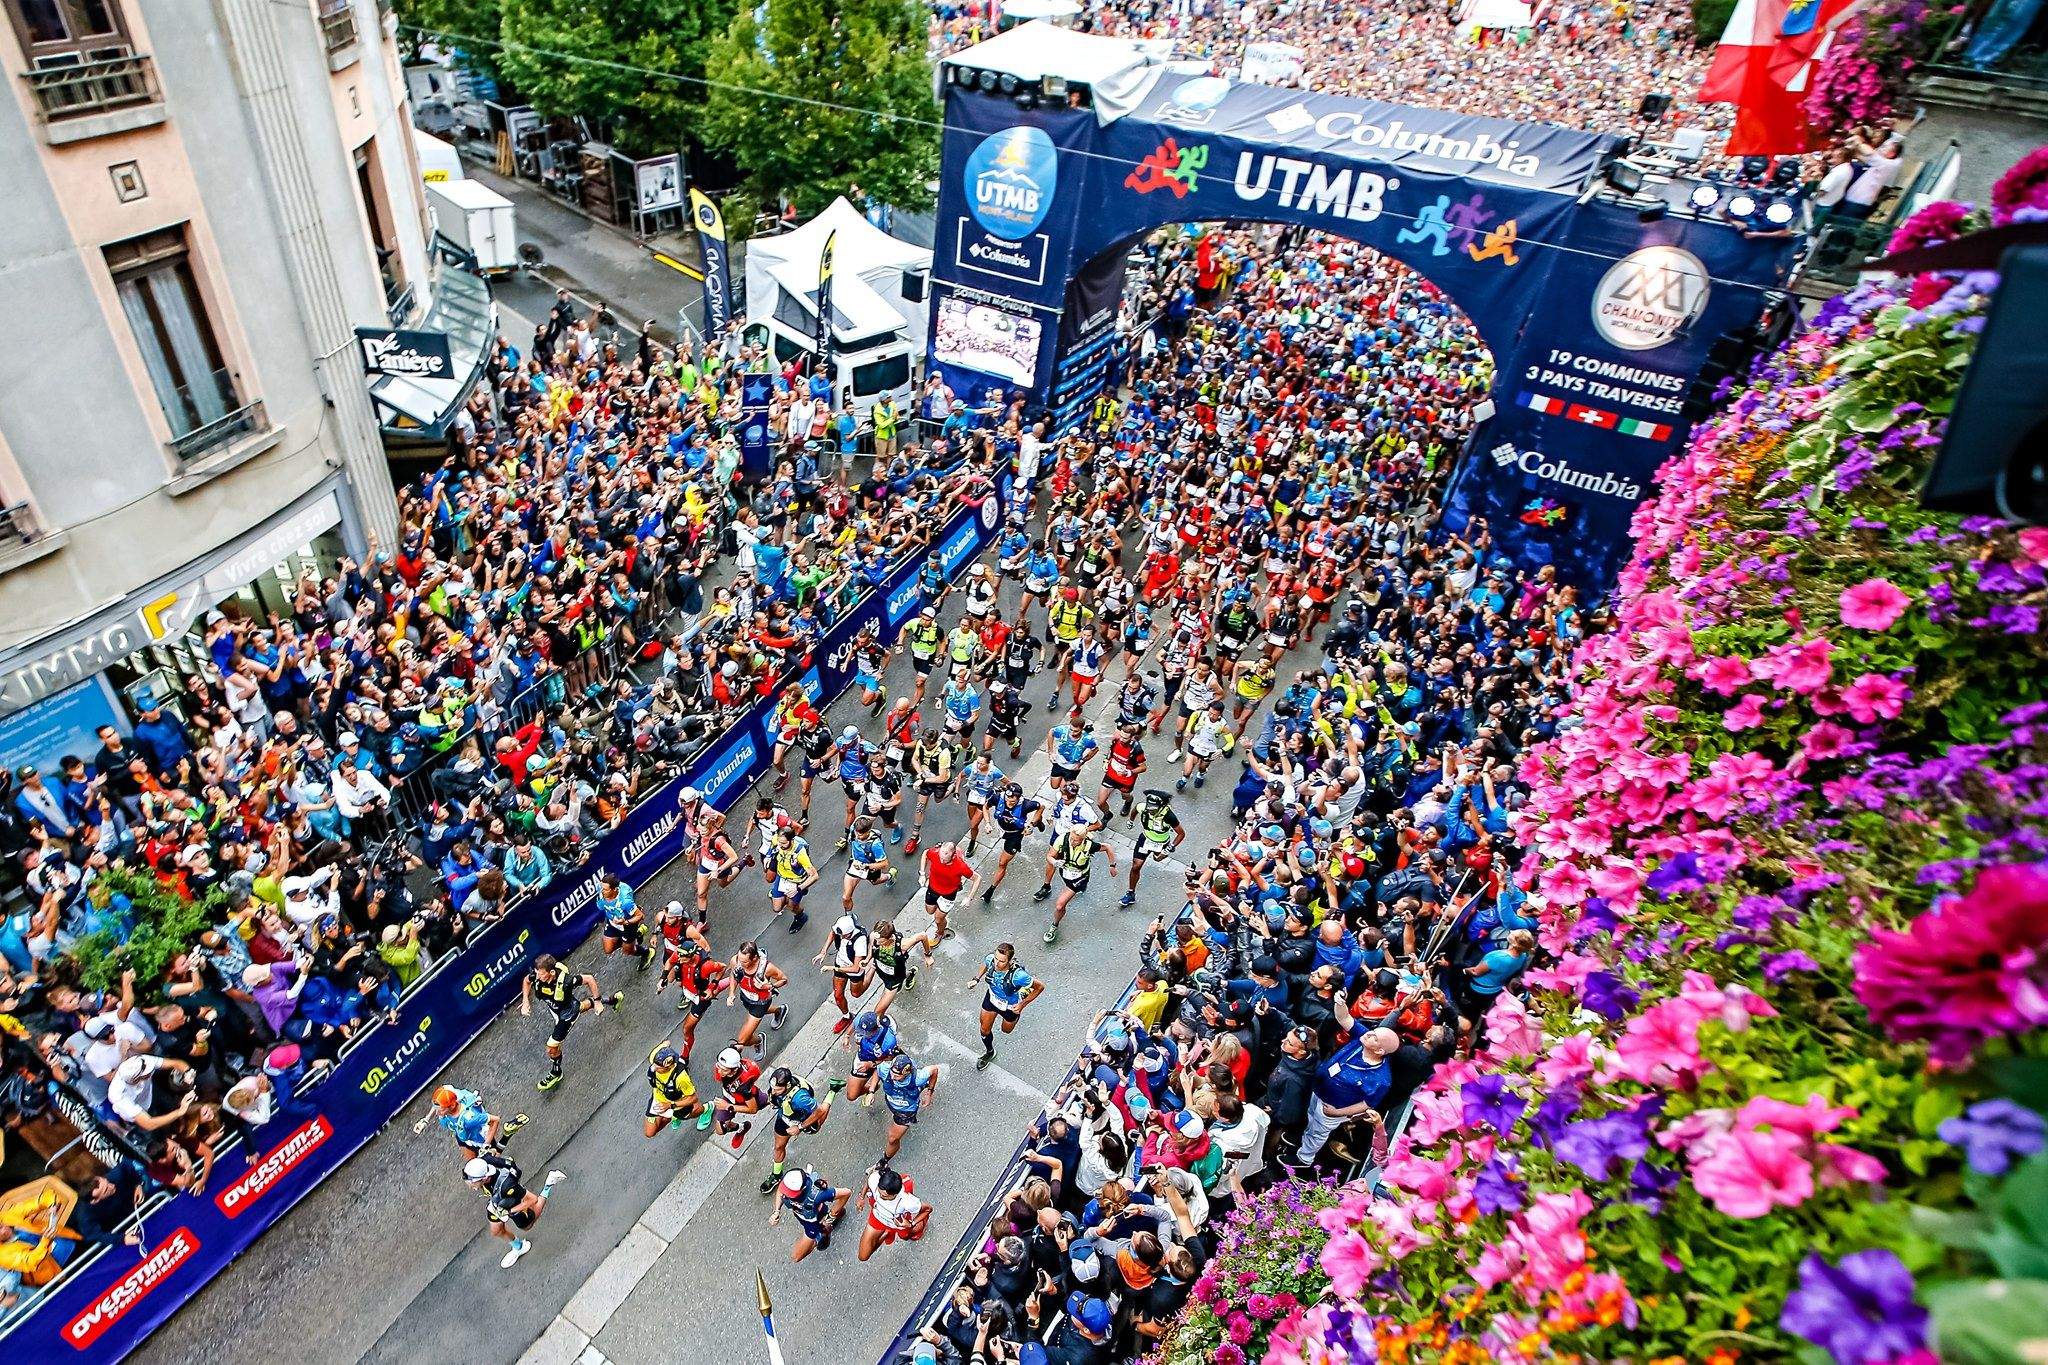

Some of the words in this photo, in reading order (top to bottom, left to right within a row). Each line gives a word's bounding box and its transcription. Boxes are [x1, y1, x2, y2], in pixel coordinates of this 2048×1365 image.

[1314, 112, 1540, 177] Columbia
[976, 179, 1040, 213] UTMB
[980, 245, 1031, 268] Columbia
[1526, 366, 1539, 380] 3
[1540, 370, 1586, 394] PAYS
[1548, 350, 1572, 366] 19
[1573, 355, 1686, 392] COMMUNES
[1517, 451, 1641, 500] Columbia
[224, 549, 268, 583] Vivre
[269, 527, 304, 555] chez
[304, 510, 327, 529] soi
[947, 527, 977, 559] Columbia
[704, 745, 754, 796] Columbia
[621, 811, 676, 867] CAMELBAK
[551, 866, 608, 927] CAMELBAK
[486, 941, 525, 979] i-run
[383, 1031, 427, 1074] i-run
